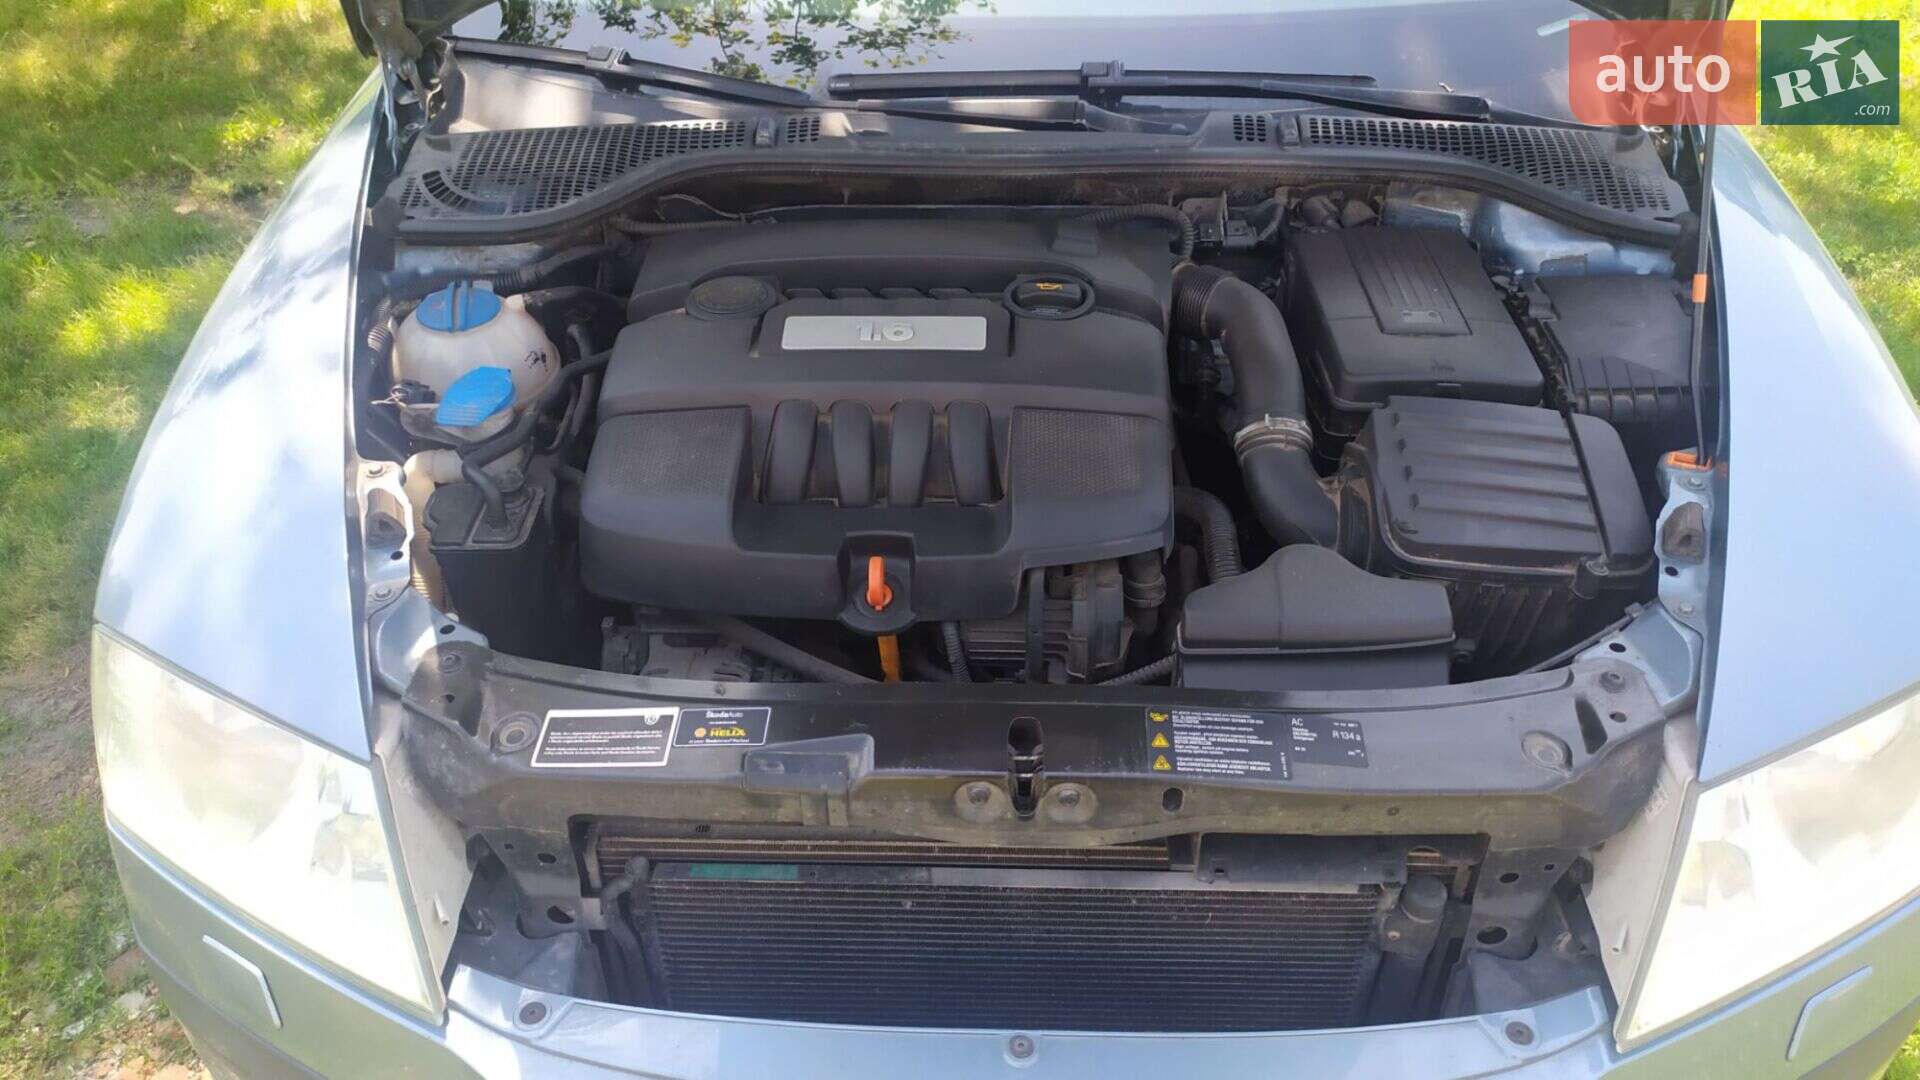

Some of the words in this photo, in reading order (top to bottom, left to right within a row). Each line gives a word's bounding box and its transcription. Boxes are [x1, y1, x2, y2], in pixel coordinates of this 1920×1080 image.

[1291, 718, 1304, 727] AC
[709, 726, 747, 738] HELIX
[1340, 731, 1355, 740] 134
